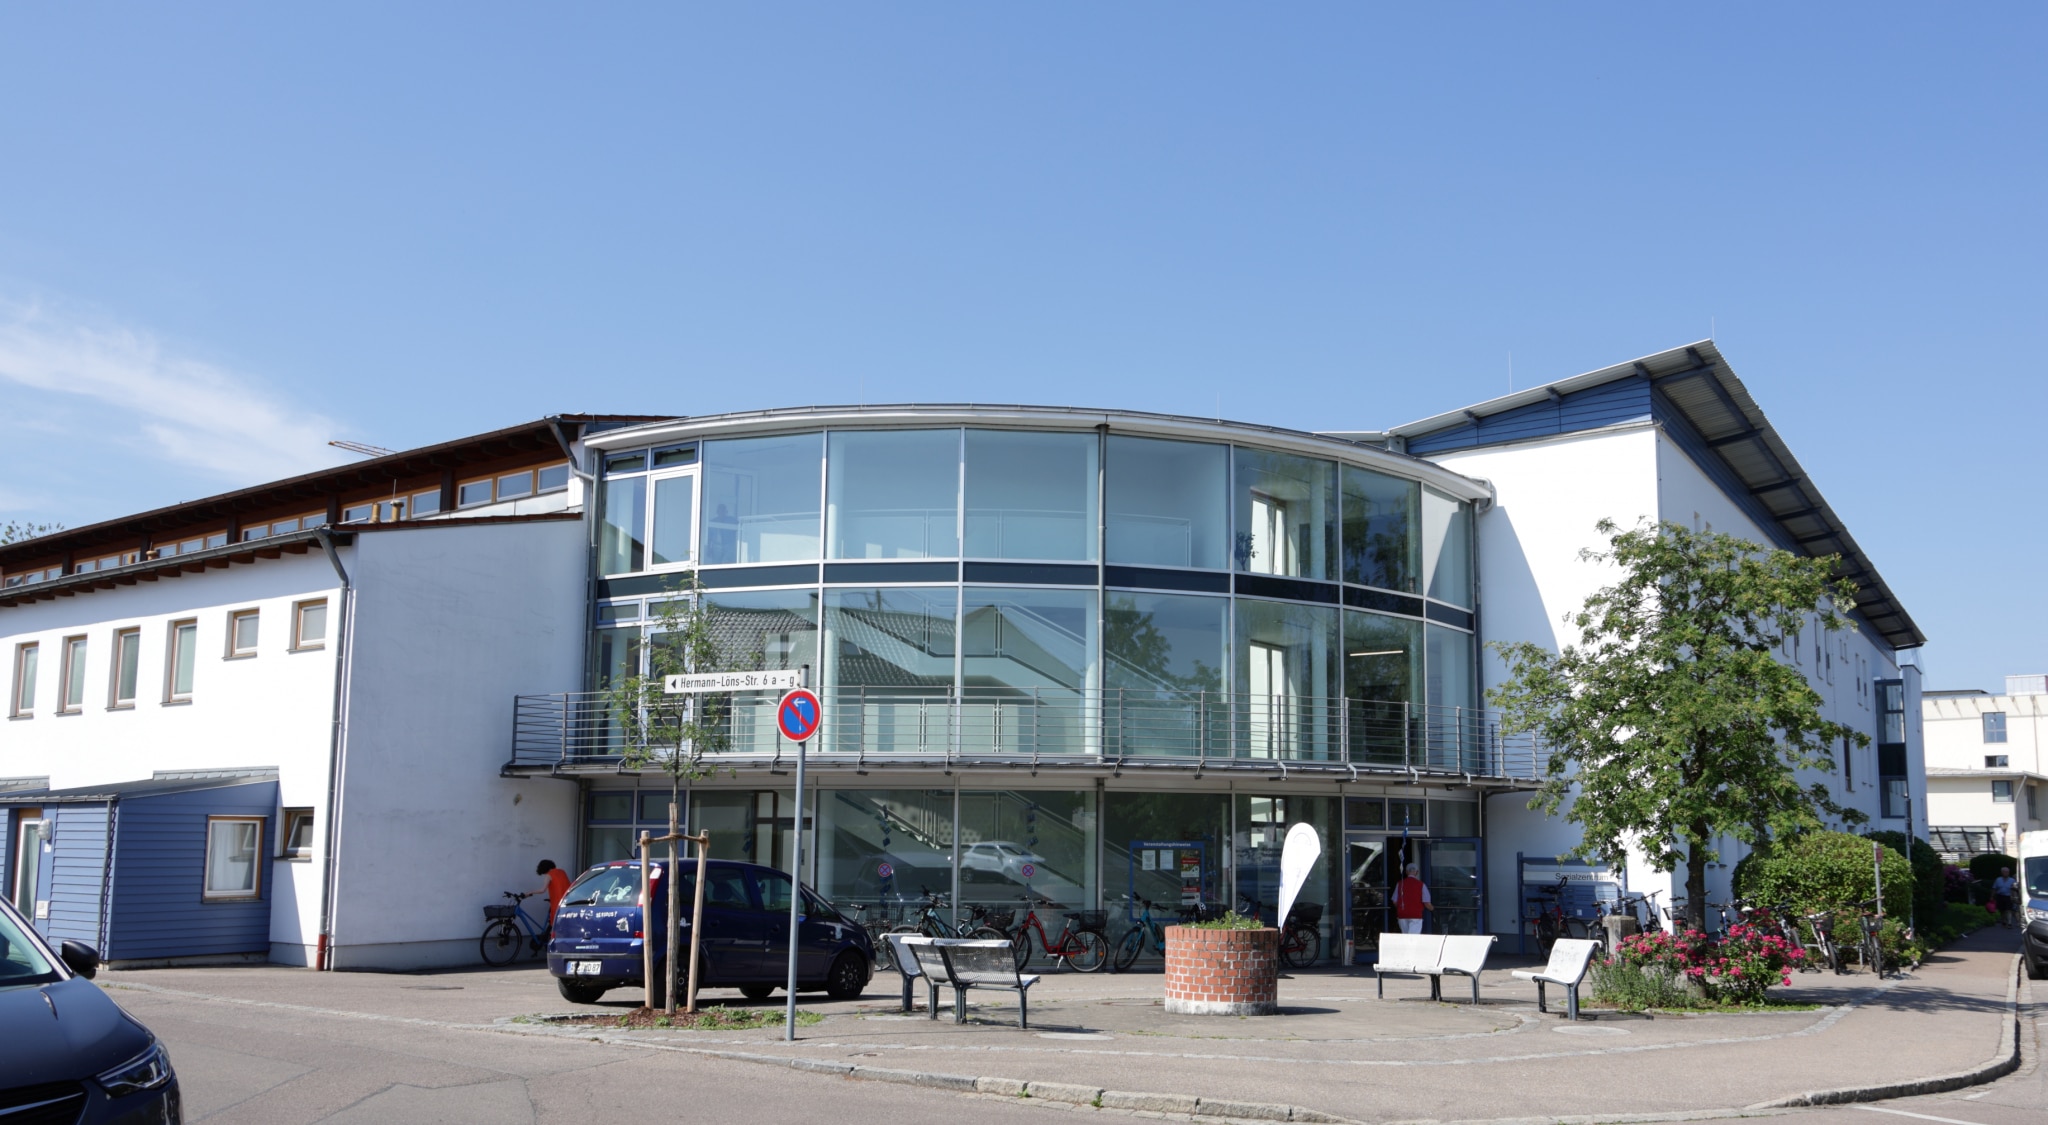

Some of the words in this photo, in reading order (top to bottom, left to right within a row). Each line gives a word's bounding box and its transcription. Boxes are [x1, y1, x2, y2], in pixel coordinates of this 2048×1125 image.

[680, 675, 759, 689] Hermann-Löns-Str.
[763, 674, 768, 686] 6
[771, 676, 777, 685] a
[789, 676, 795, 688] g
